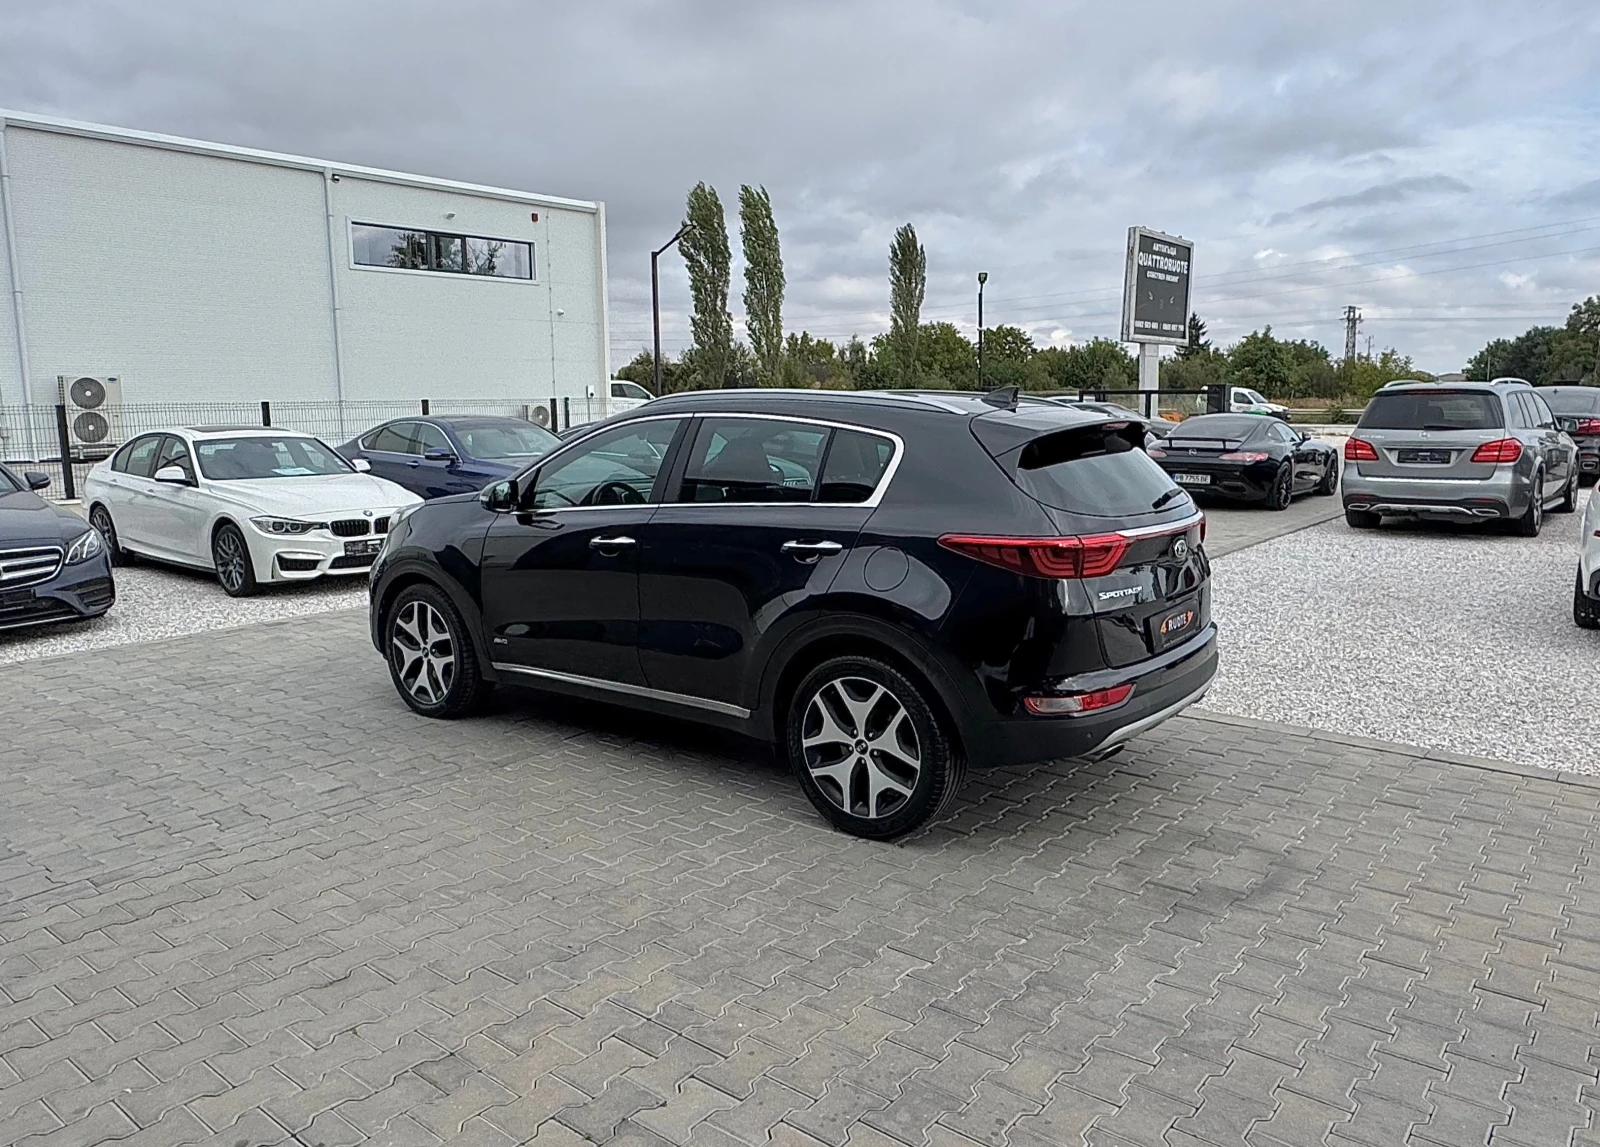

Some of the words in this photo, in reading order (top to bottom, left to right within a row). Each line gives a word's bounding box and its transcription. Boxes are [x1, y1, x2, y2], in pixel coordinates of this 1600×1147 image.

[1138, 251, 1188, 274] QUATTRORUOTE
[1185, 475, 1200, 483] 7755
[1168, 612, 1187, 631] RUOTE
